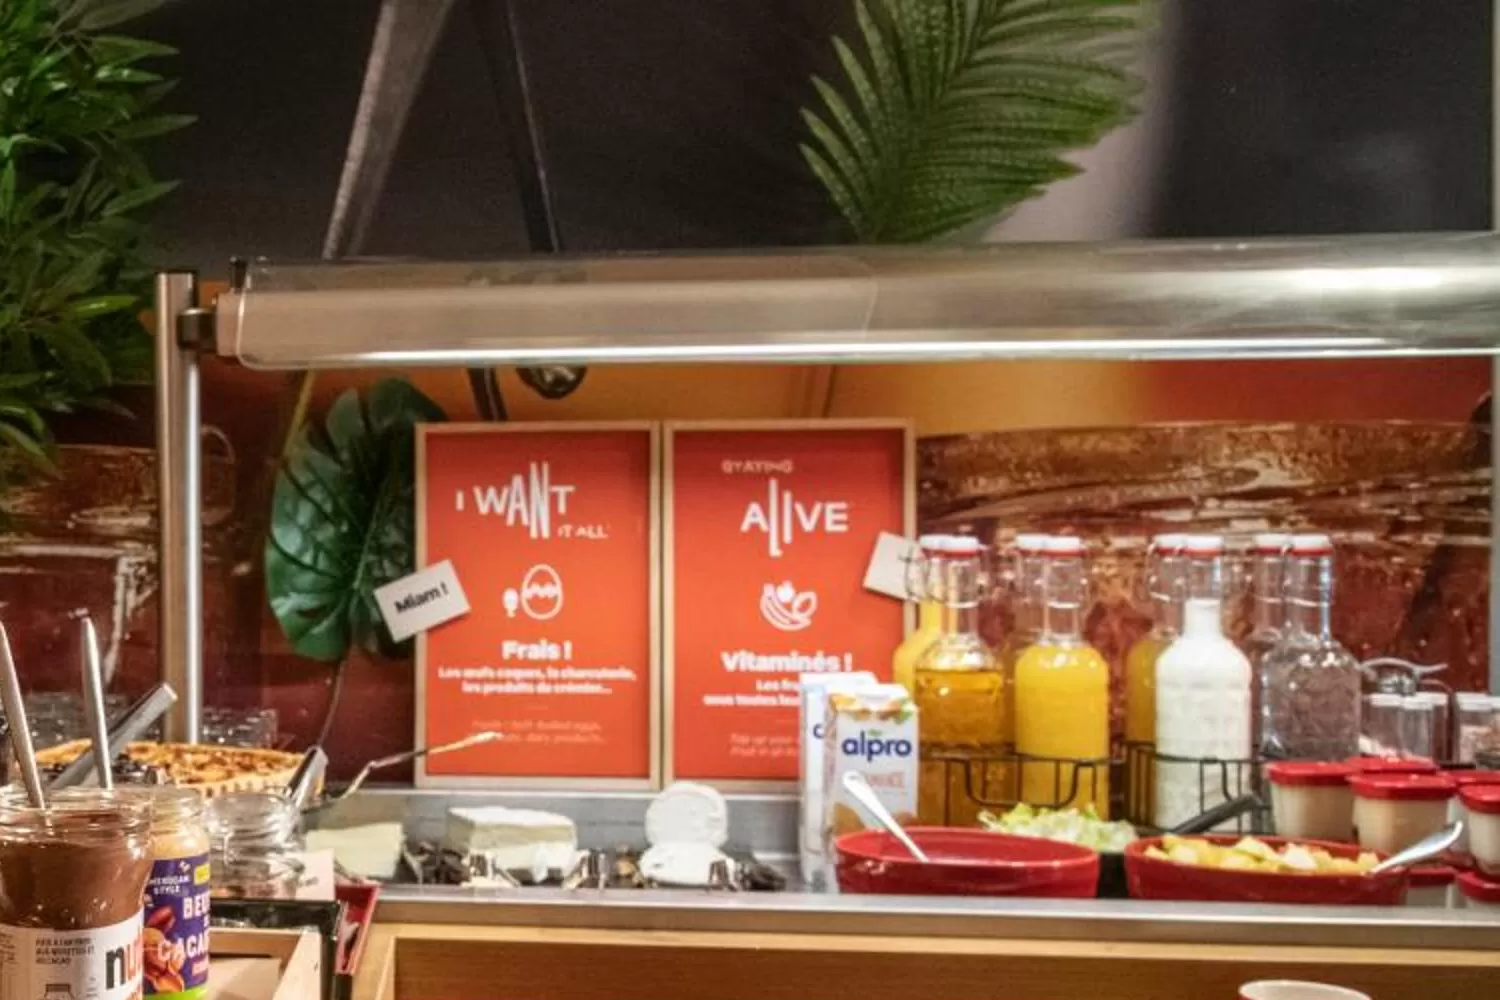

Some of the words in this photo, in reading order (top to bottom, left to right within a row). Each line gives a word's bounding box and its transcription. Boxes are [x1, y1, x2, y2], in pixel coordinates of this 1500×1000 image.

[455, 490, 464, 511] I
[473, 461, 576, 539] WANT
[740, 477, 849, 557] ALIVE
[557, 524, 572, 539] IT
[575, 524, 608, 539] ALL
[394, 586, 441, 614] Miam
[502, 638, 561, 660] Frais
[720, 648, 841, 672] Vitaminés
[841, 730, 912, 762] alpro
[183, 891, 210, 920] BEU
